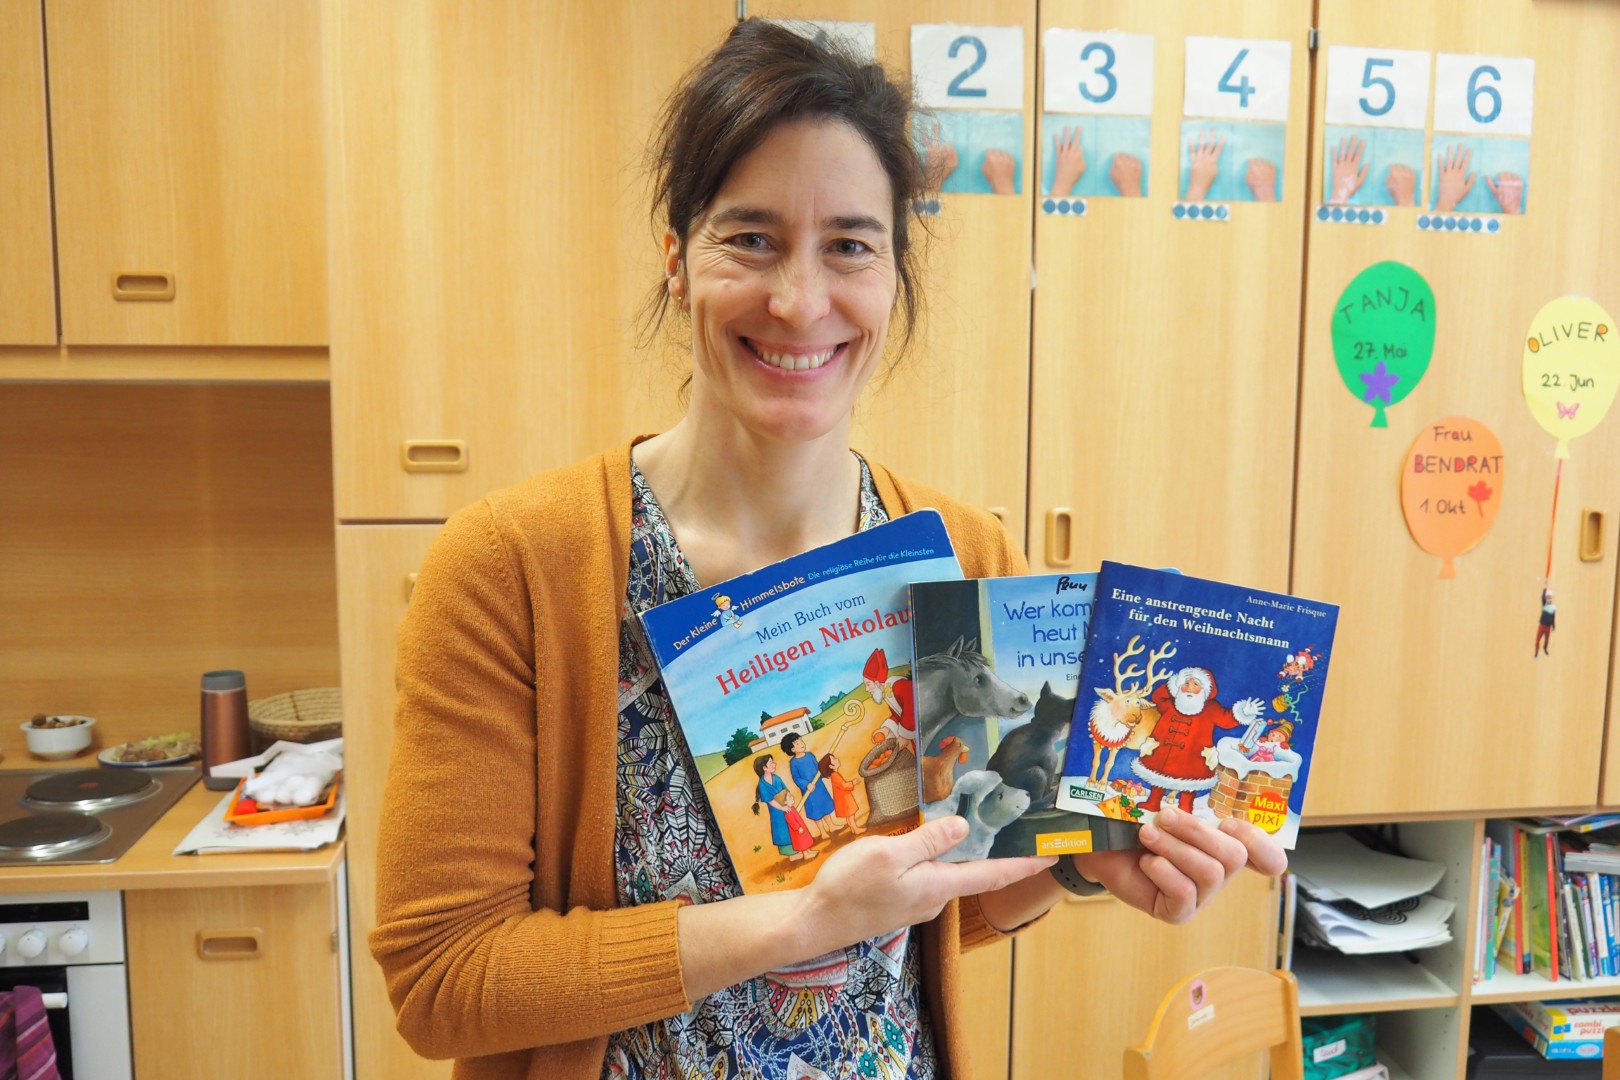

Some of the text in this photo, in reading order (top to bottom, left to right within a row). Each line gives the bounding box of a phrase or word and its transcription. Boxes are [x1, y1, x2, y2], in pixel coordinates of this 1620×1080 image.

[947, 35, 987, 97] 2
[1078, 42, 1118, 103] 3
[1217, 48, 1256, 107] 4
[1359, 58, 1396, 116] 5
[1466, 65, 1502, 123] 6
[1339, 286, 1425, 325] TANJA
[1383, 342, 1407, 359] Mai
[1527, 322, 1609, 353] OLIVER
[1569, 374, 1595, 392] Jun
[1433, 425, 1472, 442] Frau
[1414, 454, 1503, 473] BENDRAT
[1436, 499, 1466, 514] Okt
[673, 635, 691, 651] Der
[739, 575, 806, 611] Himmelsbote
[807, 571, 821, 581] Die
[822, 562, 853, 576] religiöse
[853, 556, 875, 568] Reihe
[875, 553, 887, 563] für
[888, 552, 900, 560] die
[900, 547, 935, 558] Kleinsten
[1003, 601, 1046, 621] Wer
[1112, 588, 1275, 629] Eine anstrengende Nacht
[1246, 595, 1327, 618] Anne-Marie Frisque
[755, 595, 866, 643] Mein Buch vom
[1128, 609, 1290, 649] für den Weihnachtsmann
[1033, 623, 1077, 643] heut
[715, 639, 816, 696] Heiligen
[1017, 651, 1035, 668] in
[1070, 788, 1103, 800] CARLSEN
[1254, 796, 1286, 811] Maxi
[1253, 812, 1281, 826] pixi
